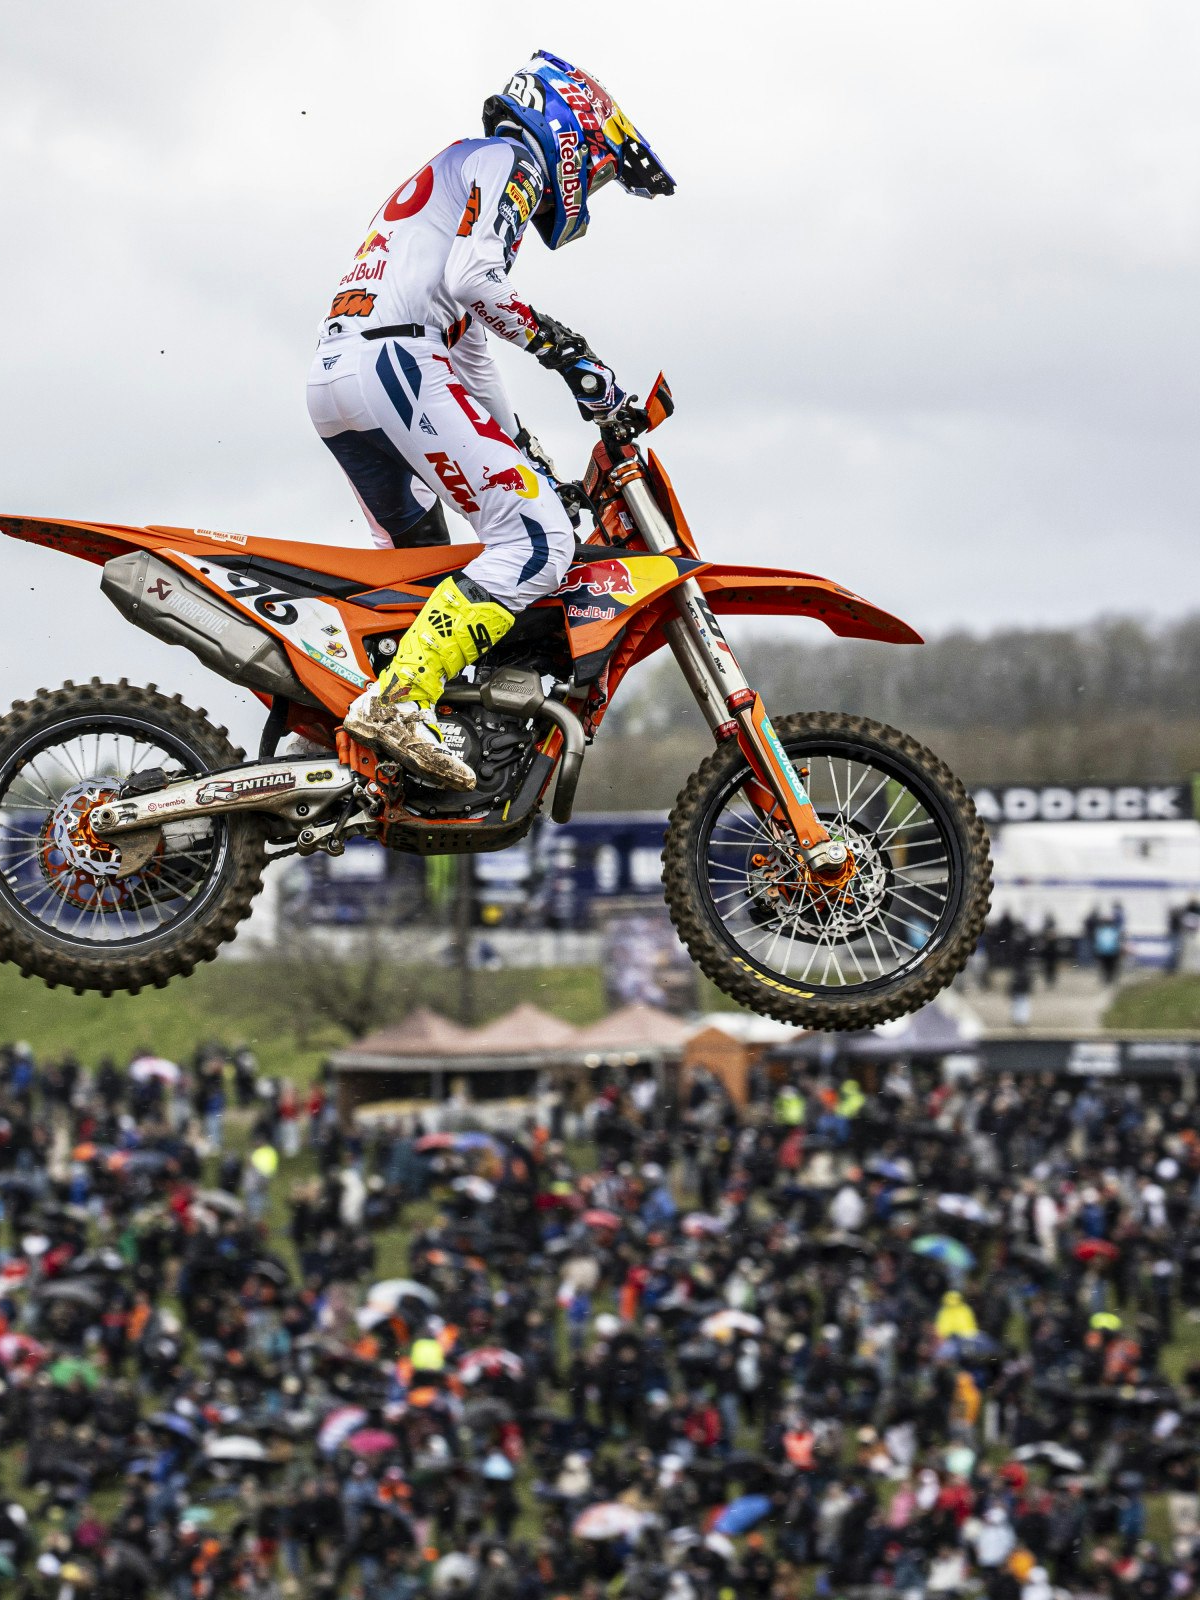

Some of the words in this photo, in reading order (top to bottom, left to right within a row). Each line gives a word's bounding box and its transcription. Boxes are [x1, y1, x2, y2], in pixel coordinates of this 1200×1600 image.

[558, 83, 608, 157] 100%
[558, 131, 581, 175] Red
[563, 178, 581, 219] Bull
[339, 263, 358, 286] ed
[356, 259, 387, 282] Bull
[470, 300, 499, 324] Red
[491, 318, 520, 341] Bull
[424, 452, 481, 513] KTM
[224, 572, 298, 625] 96
[568, 605, 590, 617] Red
[591, 606, 615, 619] Bull
[320, 656, 363, 688] MOTOREX
[774, 740, 808, 800] MOTOREX
[158, 798, 186, 809] brembo
[974, 786, 1182, 821] ADDOCK
[731, 956, 816, 999] PIRELLI
